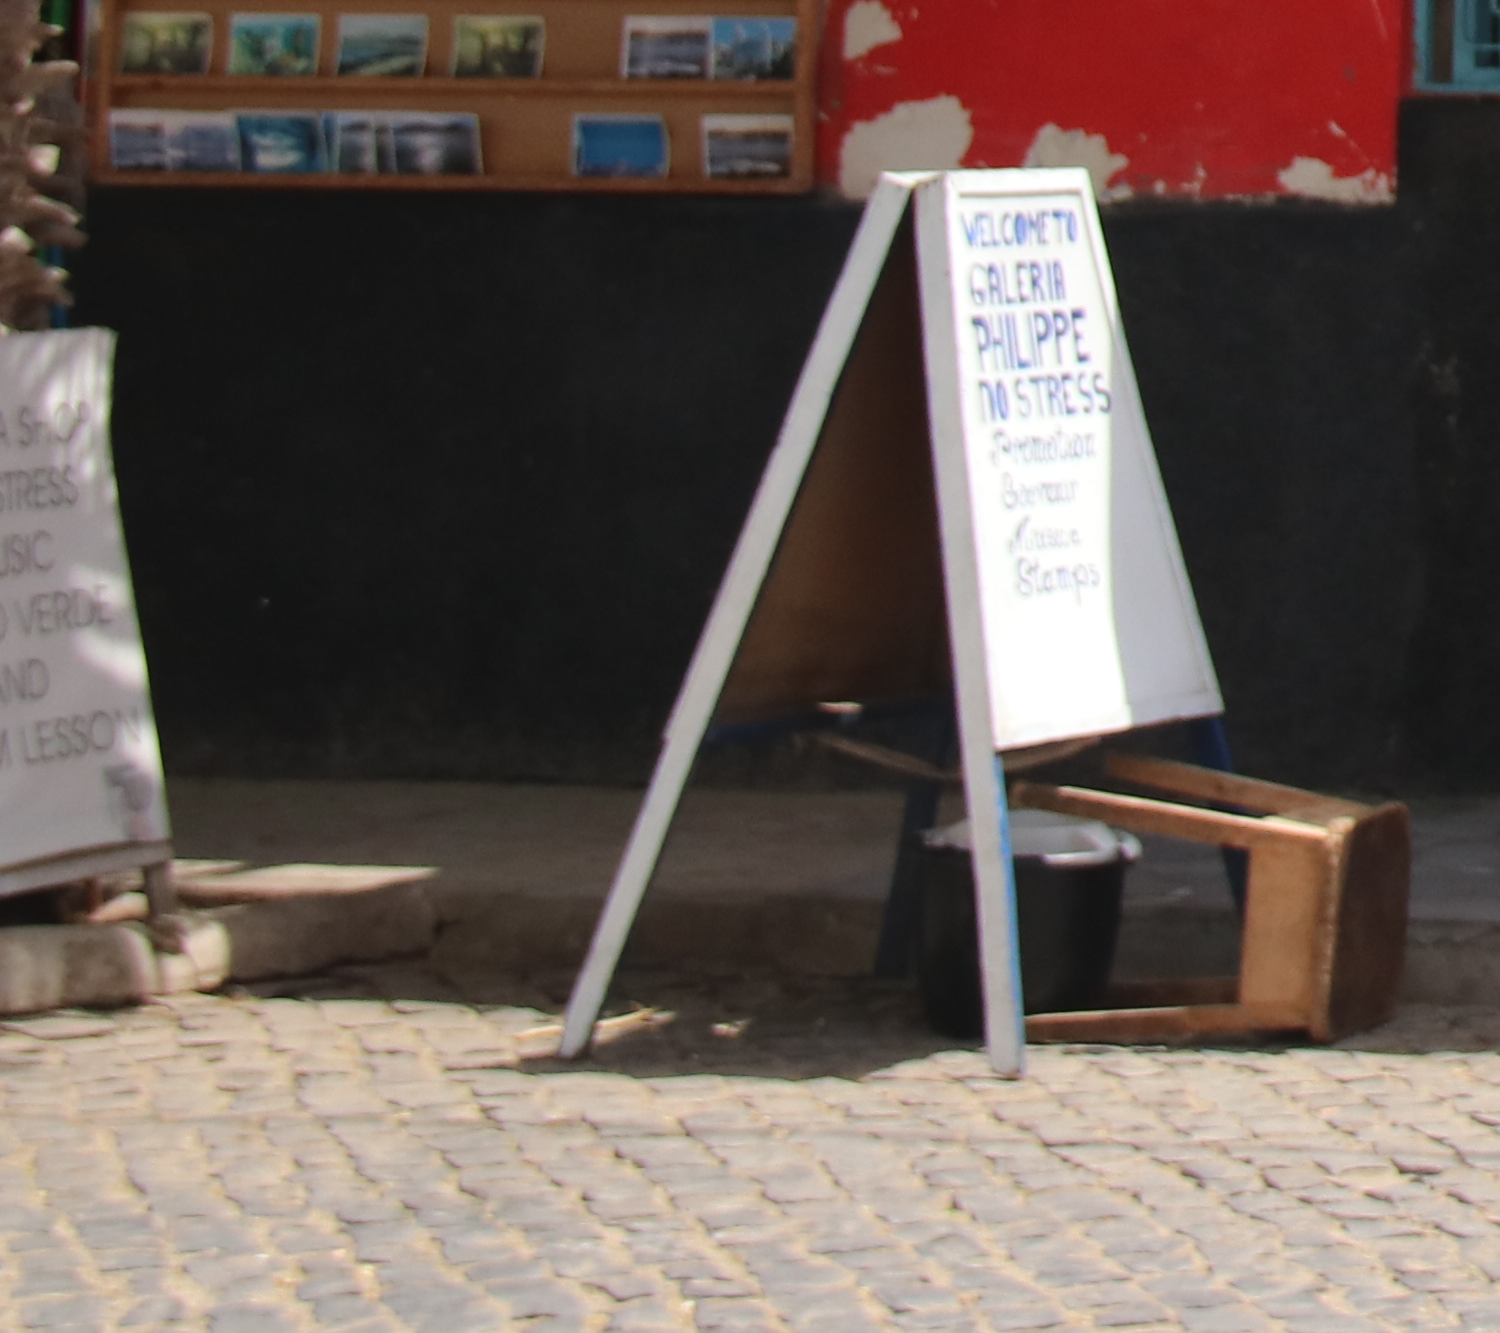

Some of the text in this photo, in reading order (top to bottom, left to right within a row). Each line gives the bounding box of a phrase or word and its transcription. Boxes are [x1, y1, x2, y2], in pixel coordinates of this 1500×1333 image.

[961, 210, 1049, 248] WELCOME
[968, 259, 1067, 306] GALERIA
[971, 307, 1089, 371] PHILIPPE
[1015, 373, 1112, 418] STRESS
[1016, 556, 1101, 606] Stamps
